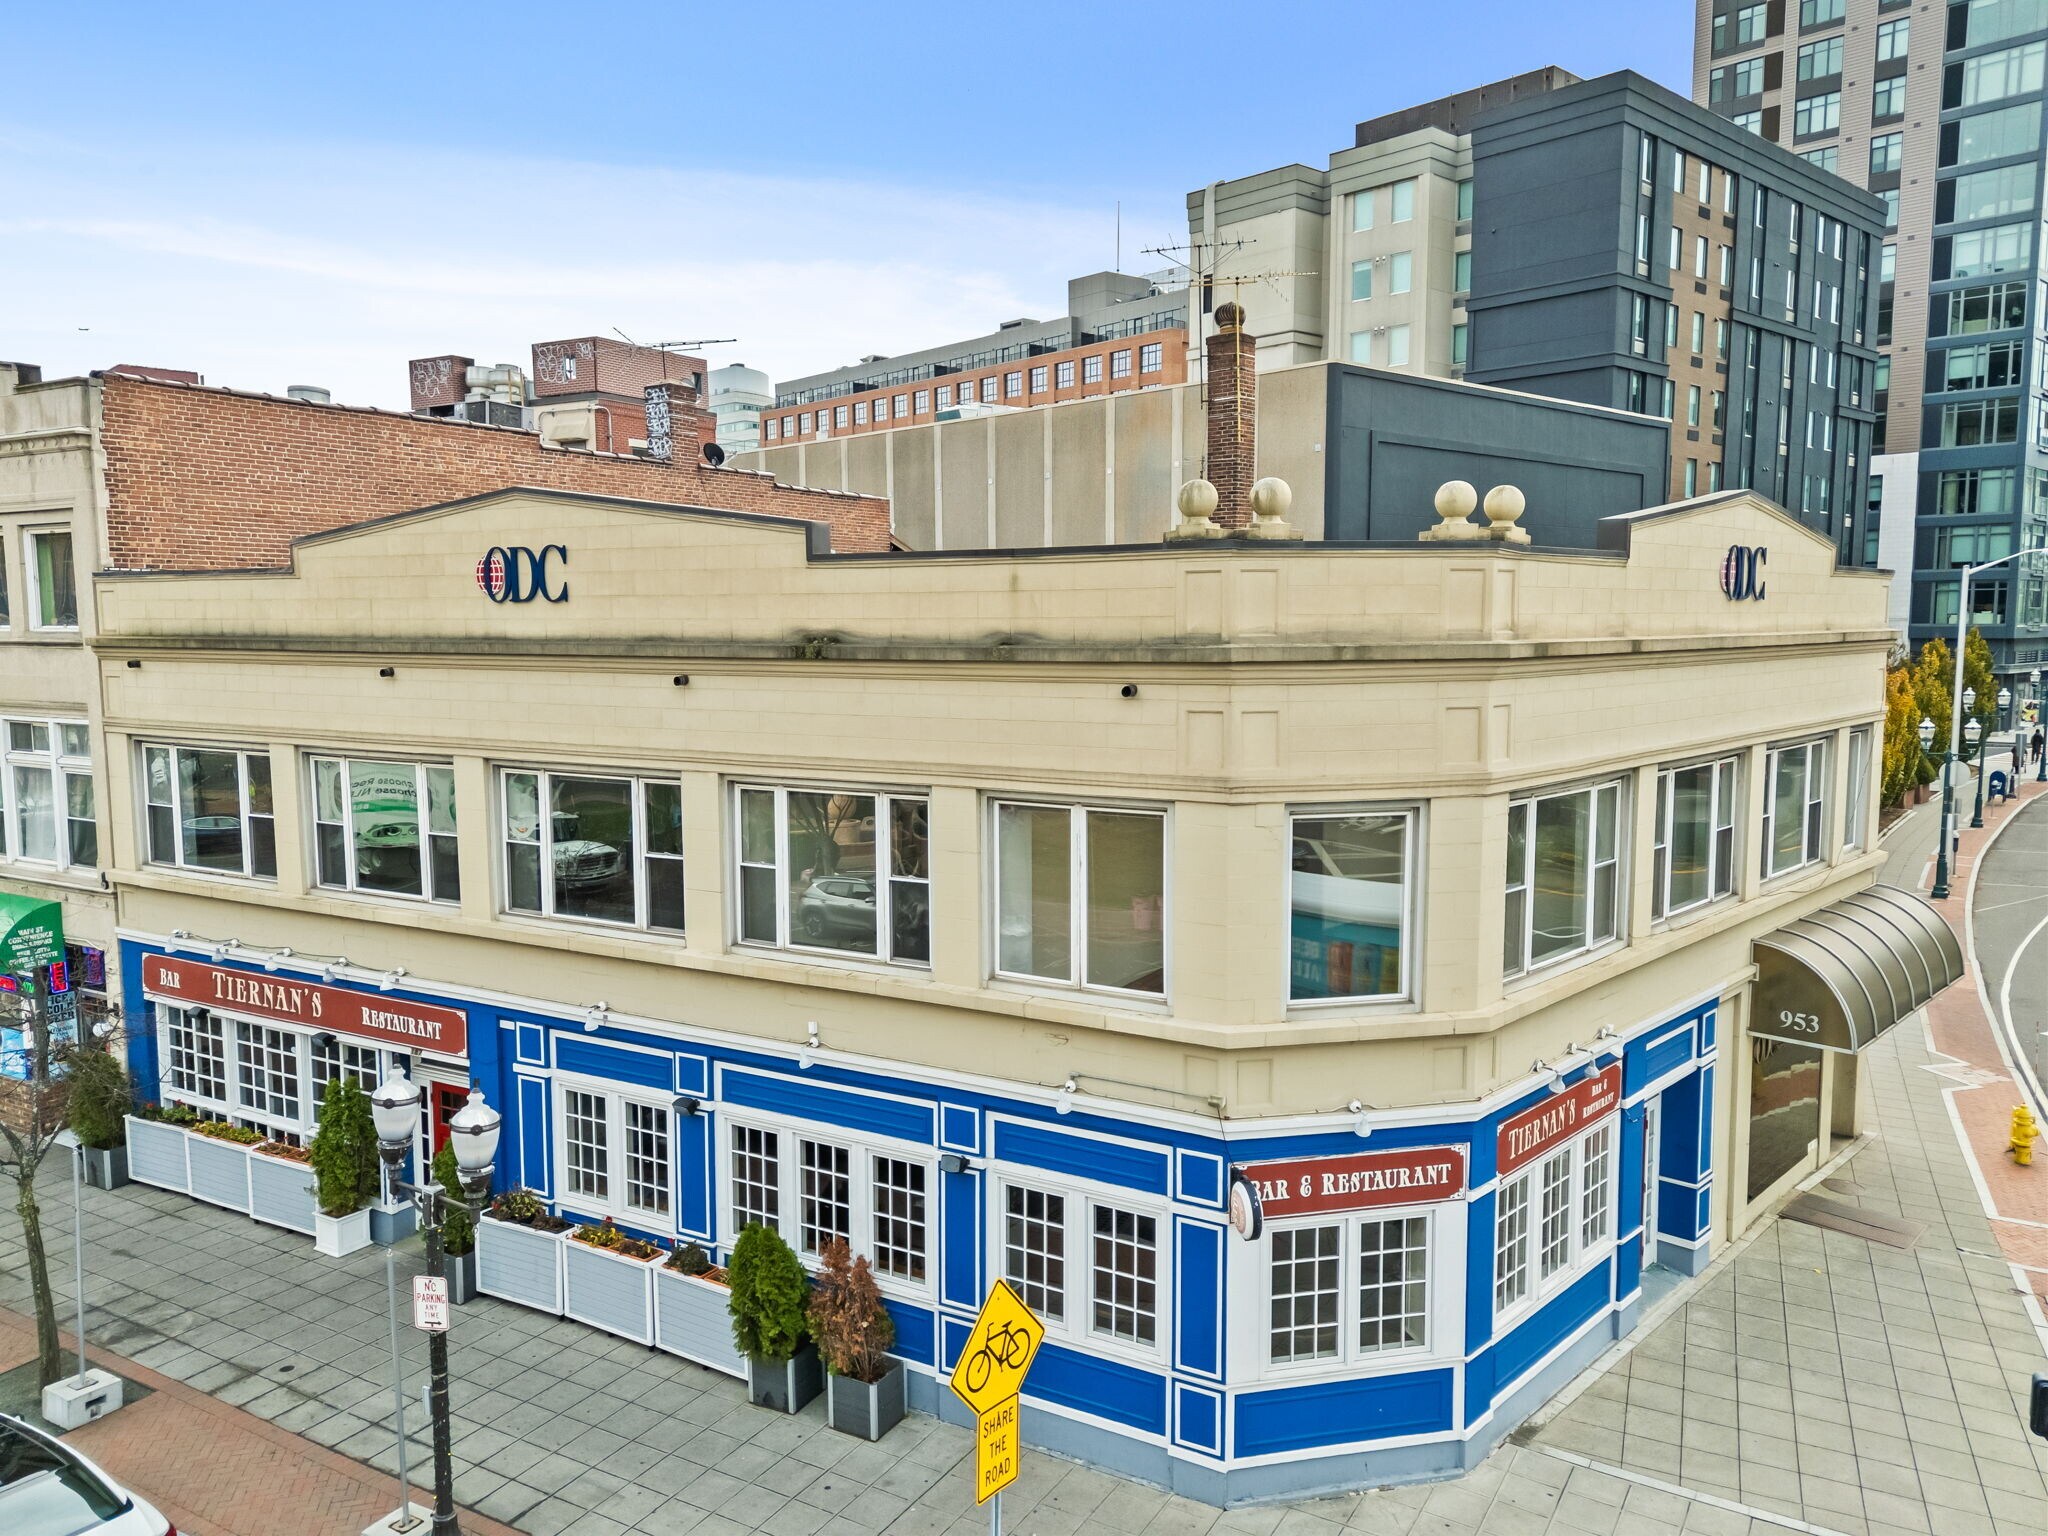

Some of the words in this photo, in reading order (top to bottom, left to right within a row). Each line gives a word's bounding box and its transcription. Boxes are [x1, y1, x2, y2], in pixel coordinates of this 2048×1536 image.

[483, 544, 568, 603] ODC
[1724, 545, 1767, 601] ODC
[51, 993, 68, 1004] ICE
[159, 968, 181, 989] BAR
[212, 971, 322, 1018] TIERNAN'S
[361, 1006, 442, 1040] RESTAURANT
[1780, 1010, 1820, 1033] 953
[1591, 1083, 1602, 1097] BAR
[1582, 1091, 1615, 1119] RESTAURANT
[1508, 1098, 1576, 1160] TIERNAN'S
[1300, 1175, 1312, 1198] &
[1321, 1163, 1452, 1196] RESTAURANT
[416, 1292, 446, 1304] PARKING
[424, 1311, 439, 1319] TIME
[983, 1406, 1014, 1439] SHARE
[989, 1434, 1007, 1459] THE
[985, 1457, 1011, 1488] ROAD
